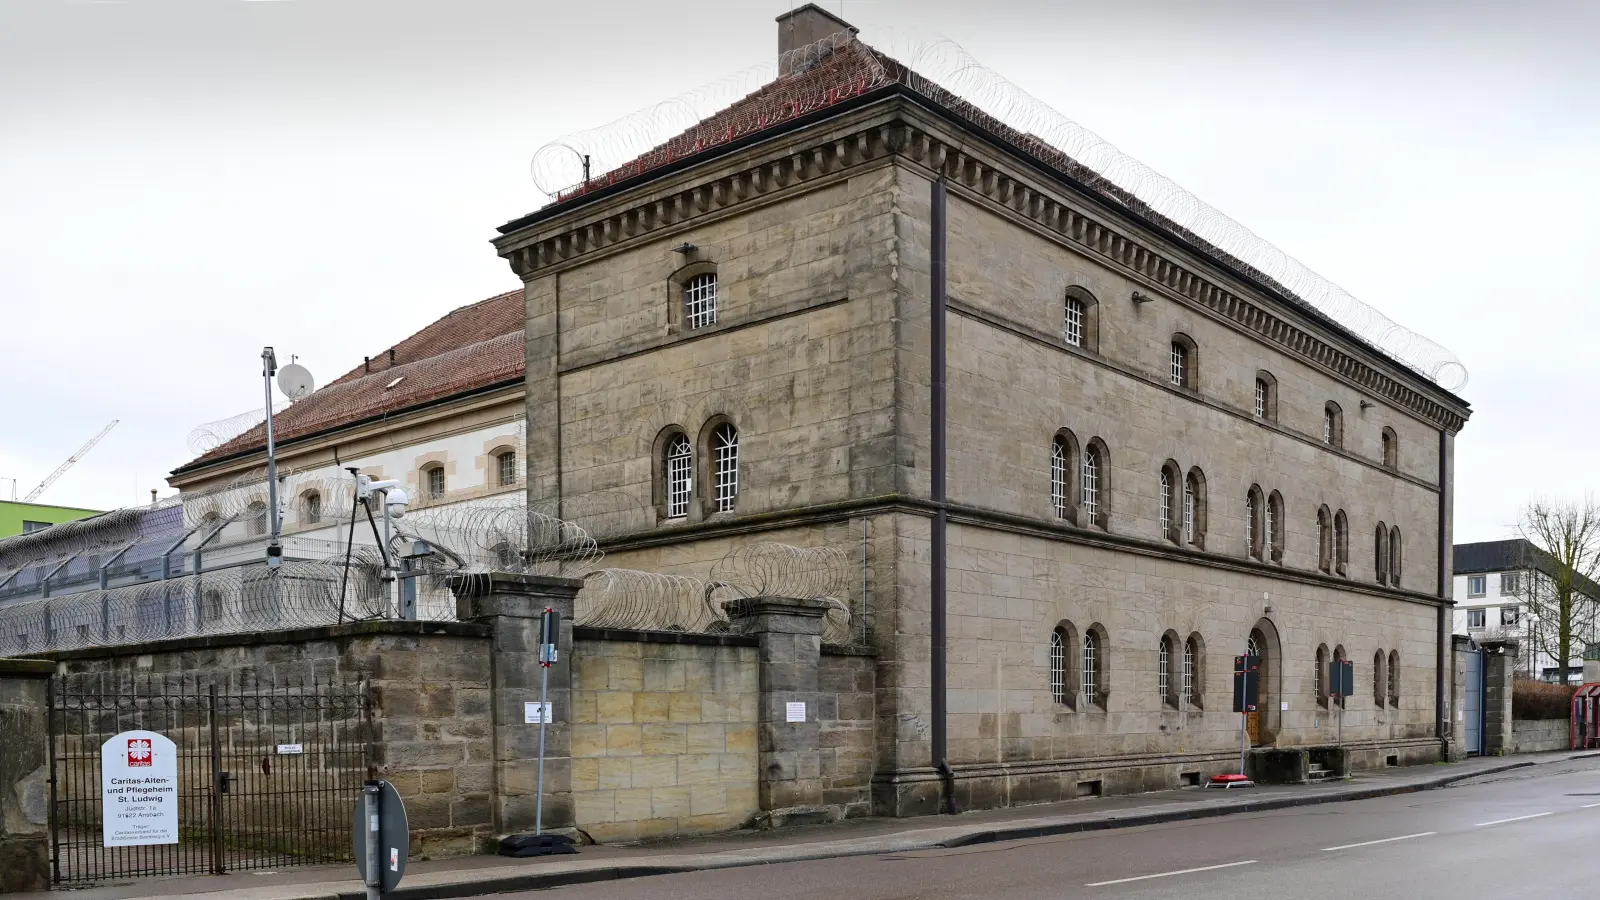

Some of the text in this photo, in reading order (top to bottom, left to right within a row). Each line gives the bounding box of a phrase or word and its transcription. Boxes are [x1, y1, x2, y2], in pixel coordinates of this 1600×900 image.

[111, 777, 169, 785] Caritas-Alten-
[126, 786, 173, 795] Pflegeheim
[132, 795, 163, 803] Ludwig
